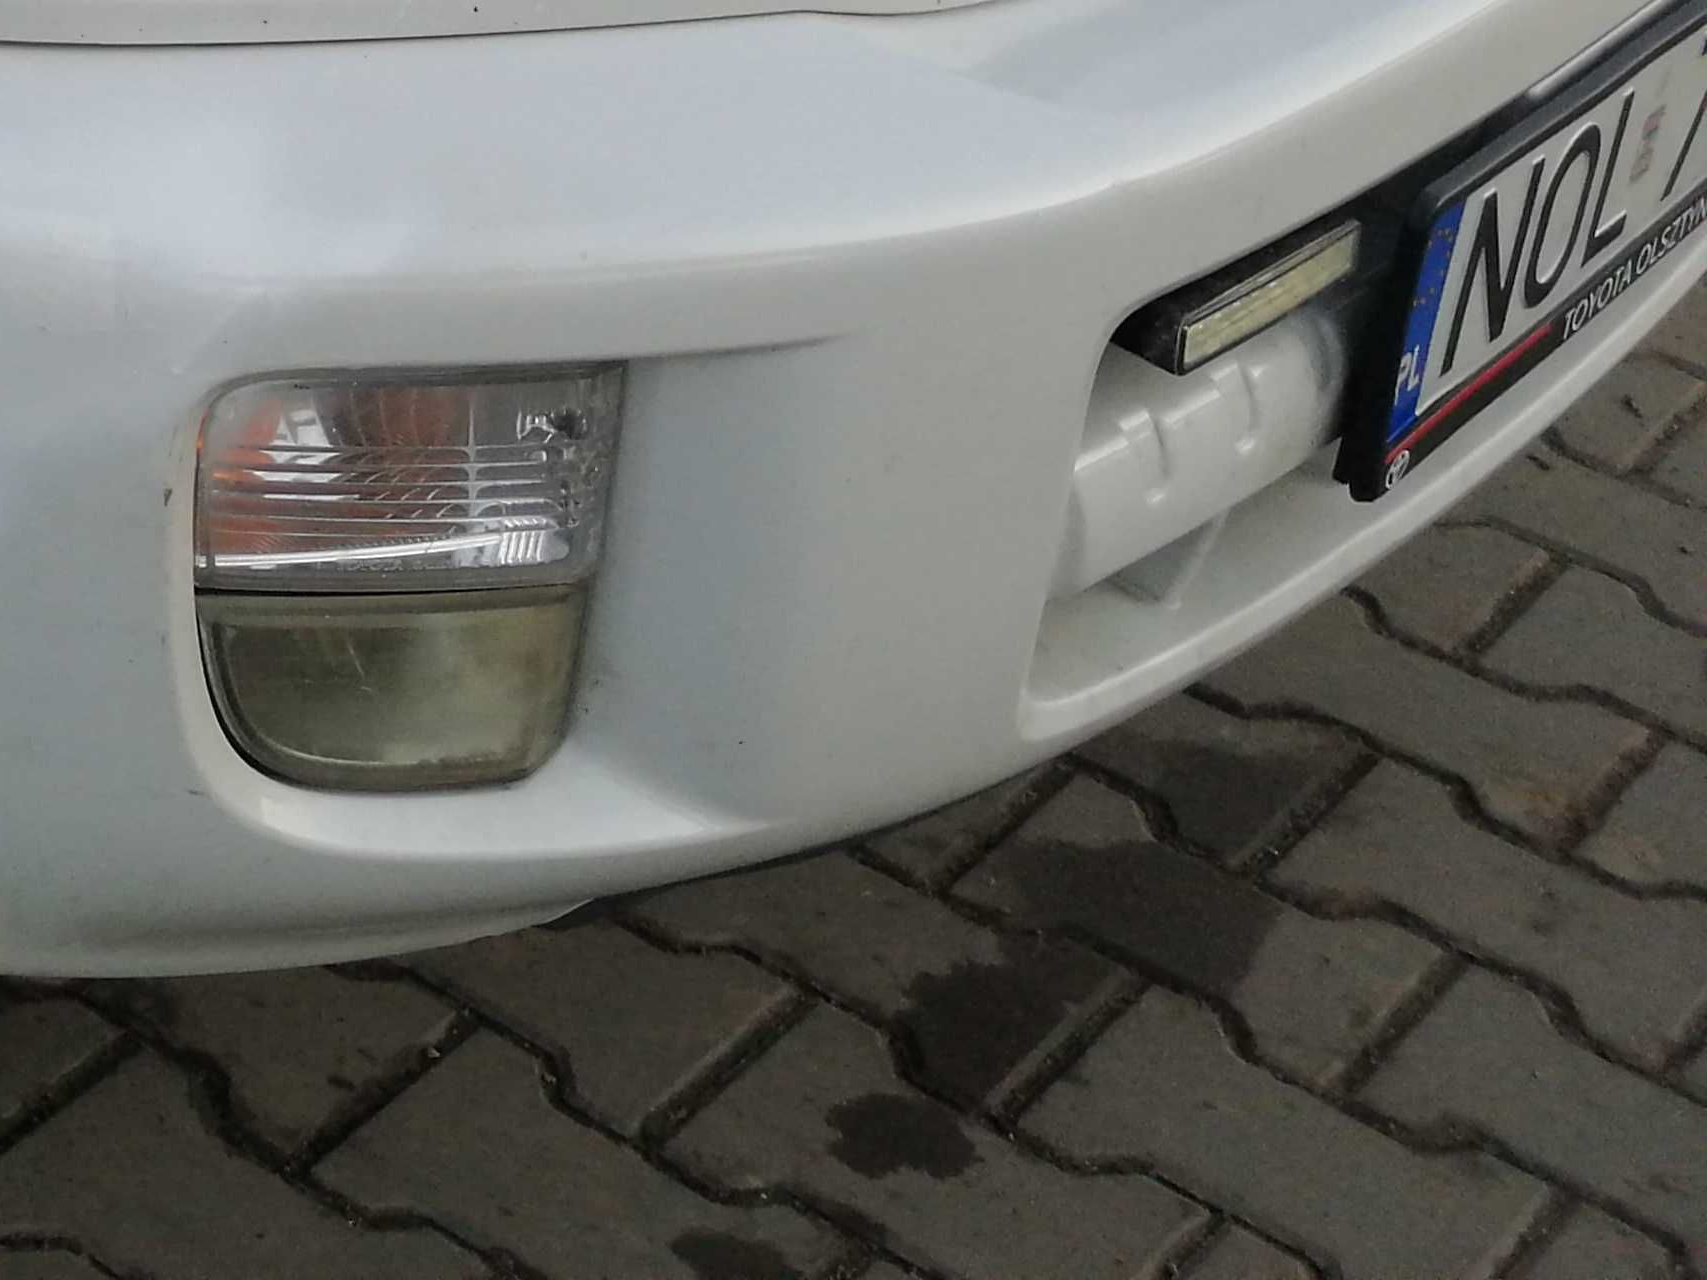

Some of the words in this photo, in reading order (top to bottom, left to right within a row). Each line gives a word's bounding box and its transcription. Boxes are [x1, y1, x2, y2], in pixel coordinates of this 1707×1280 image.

[1439, 87, 1635, 377] NOL
[1562, 259, 1633, 340] TOYOTA
[1394, 344, 1420, 406] PL
